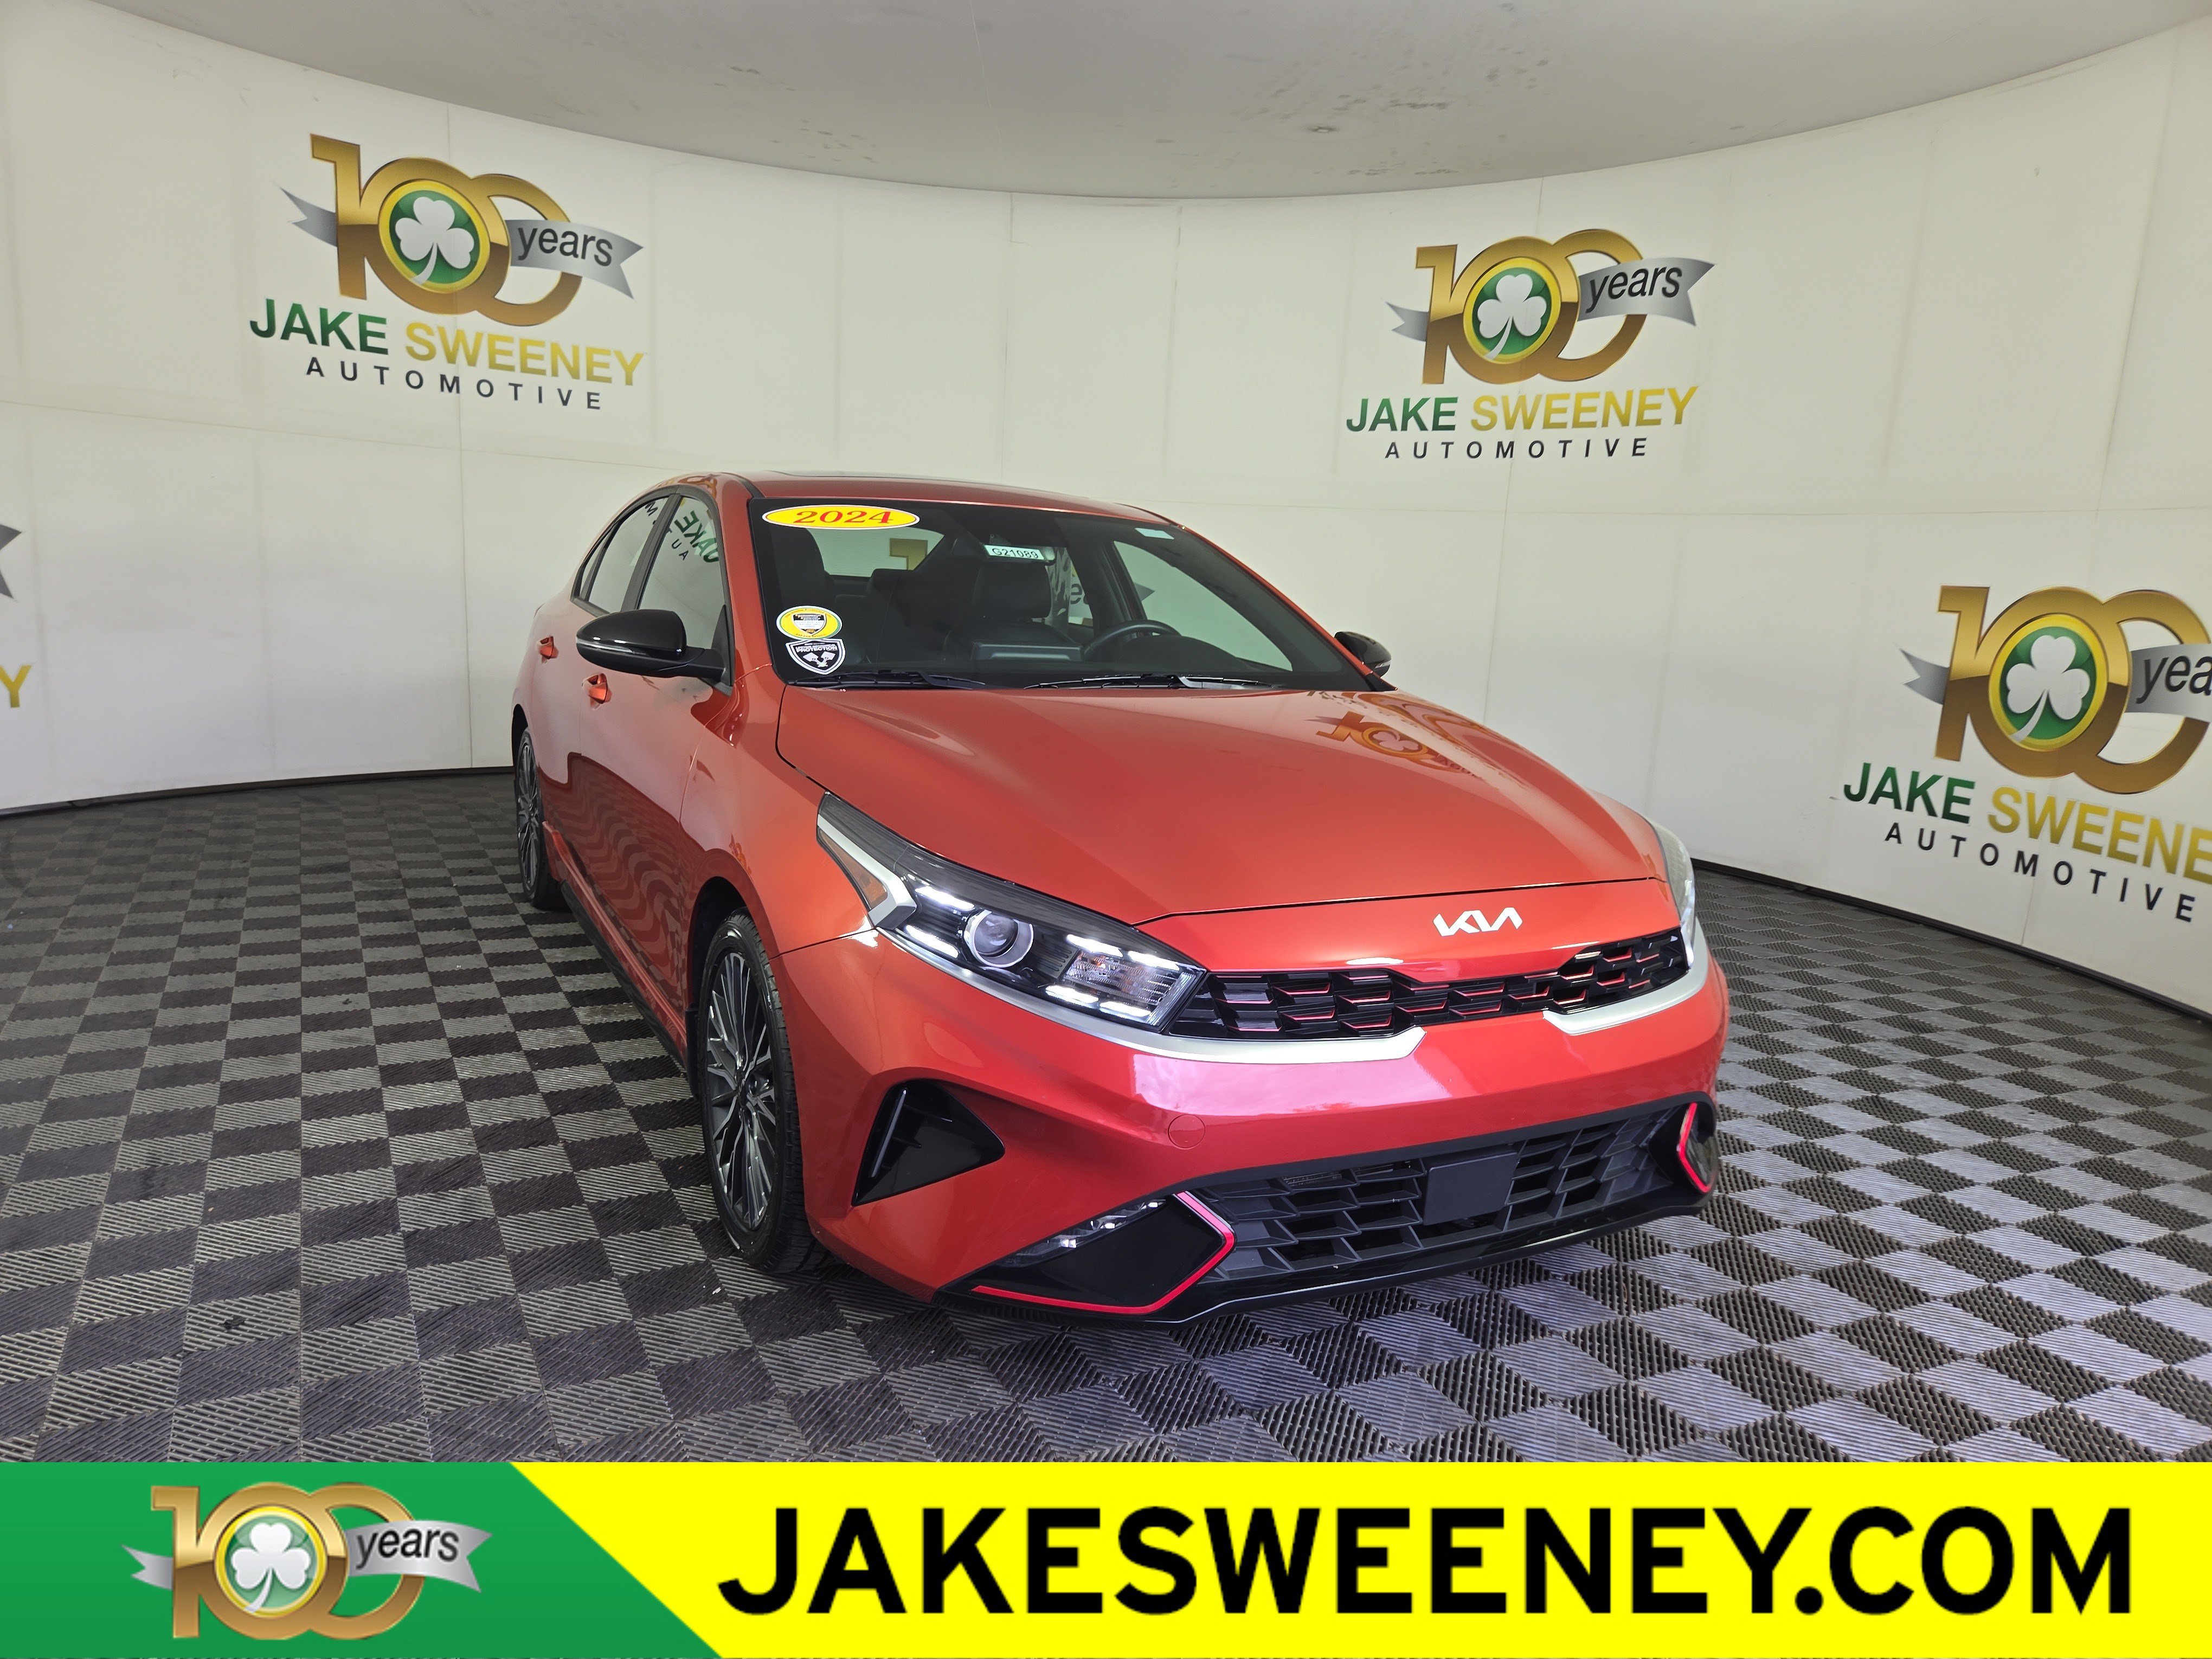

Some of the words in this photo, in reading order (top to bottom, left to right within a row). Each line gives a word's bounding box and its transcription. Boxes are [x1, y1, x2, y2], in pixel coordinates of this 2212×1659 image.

[310, 133, 583, 327] 100
[517, 227, 614, 267] years
[1415, 228, 1648, 385] 100
[1585, 266, 1682, 313] years
[249, 298, 389, 356] JAKE
[406, 321, 645, 386] SWEENEY
[306, 356, 601, 410] AUTOMOTIVE
[1346, 396, 1459, 432] JAKE
[1470, 385, 1699, 431] SWEENEY
[1385, 437, 1648, 460] AUTOMOTIVE
[793, 510, 893, 524] 2024
[992, 548, 1039, 559] G21089
[1843, 762, 1976, 825] JAKE
[1884, 822, 2196, 923] AUTOMOTIVE
[1433, 907, 1523, 937] KIA
